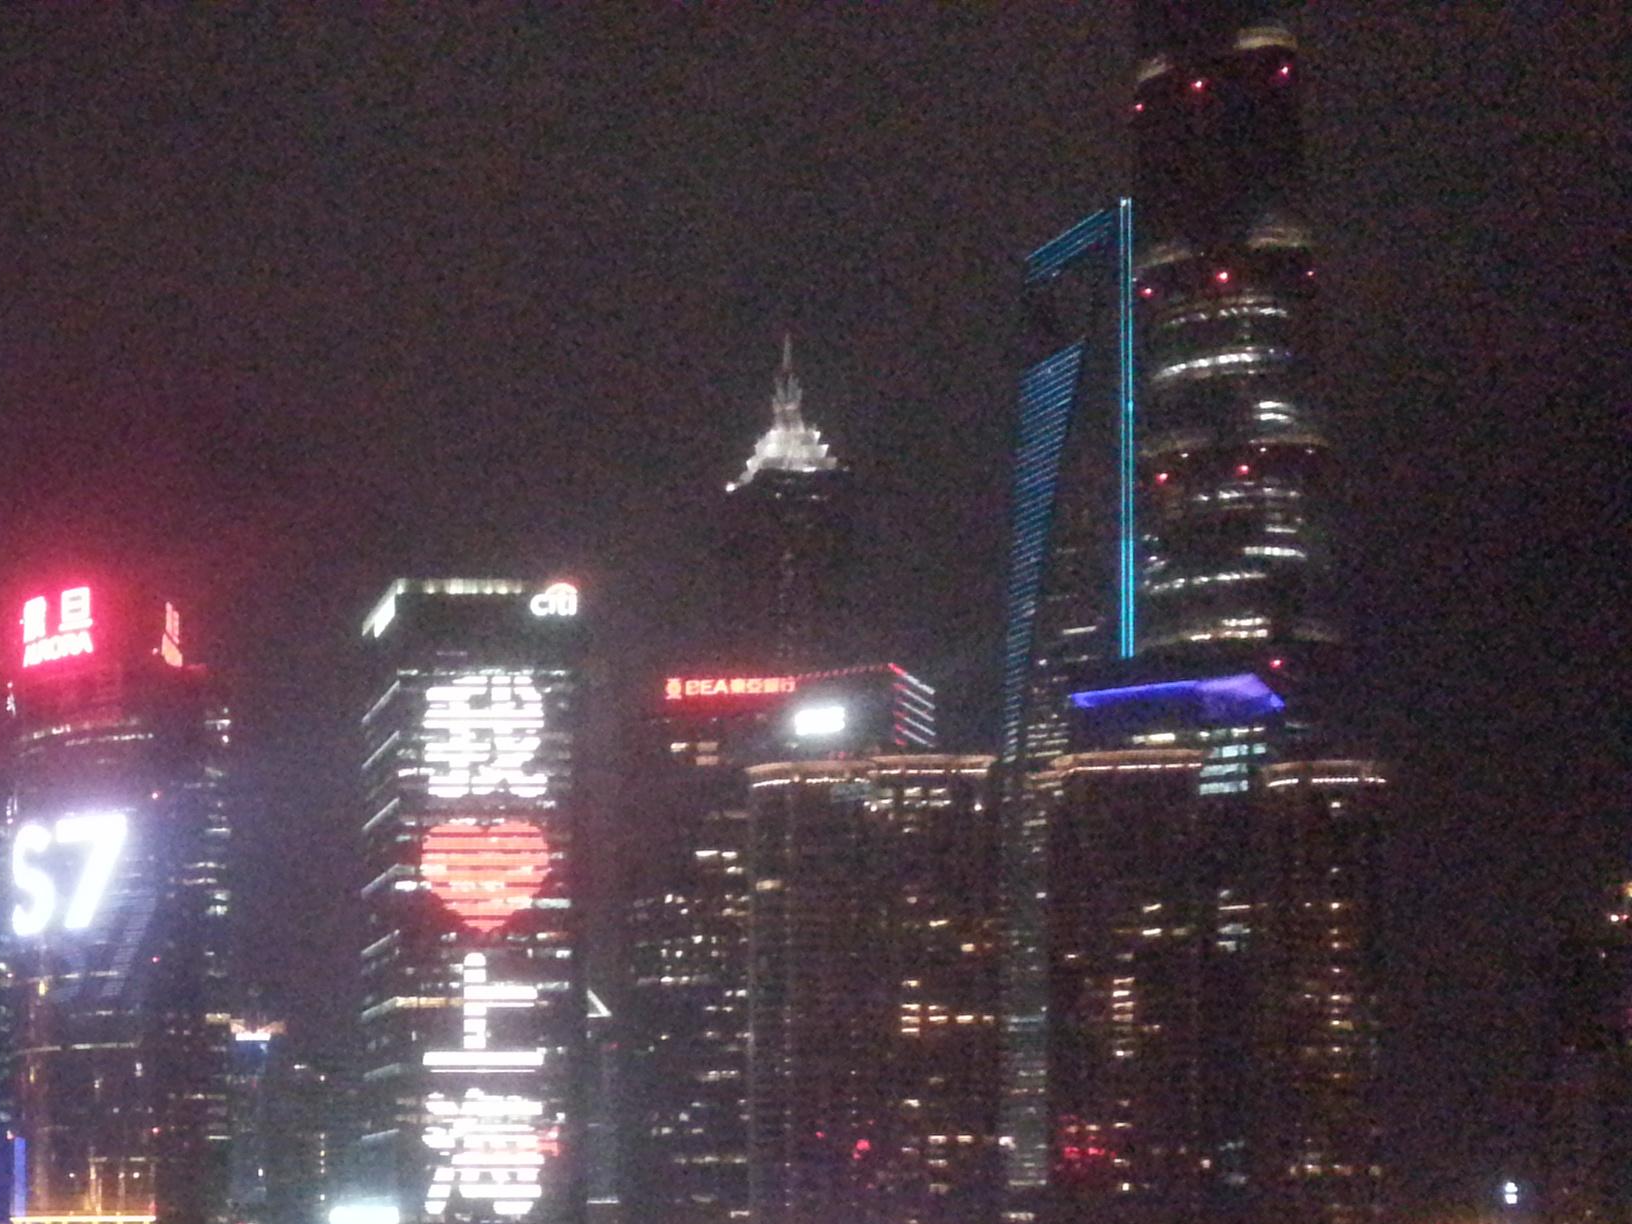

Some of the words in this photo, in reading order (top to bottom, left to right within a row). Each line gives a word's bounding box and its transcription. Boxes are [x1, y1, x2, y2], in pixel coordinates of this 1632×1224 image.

[530, 583, 578, 616] citi
[422, 675, 548, 798] 我
[684, 678, 729, 696] BEA
[11, 813, 128, 936] S7
[421, 952, 546, 1215] 上海
